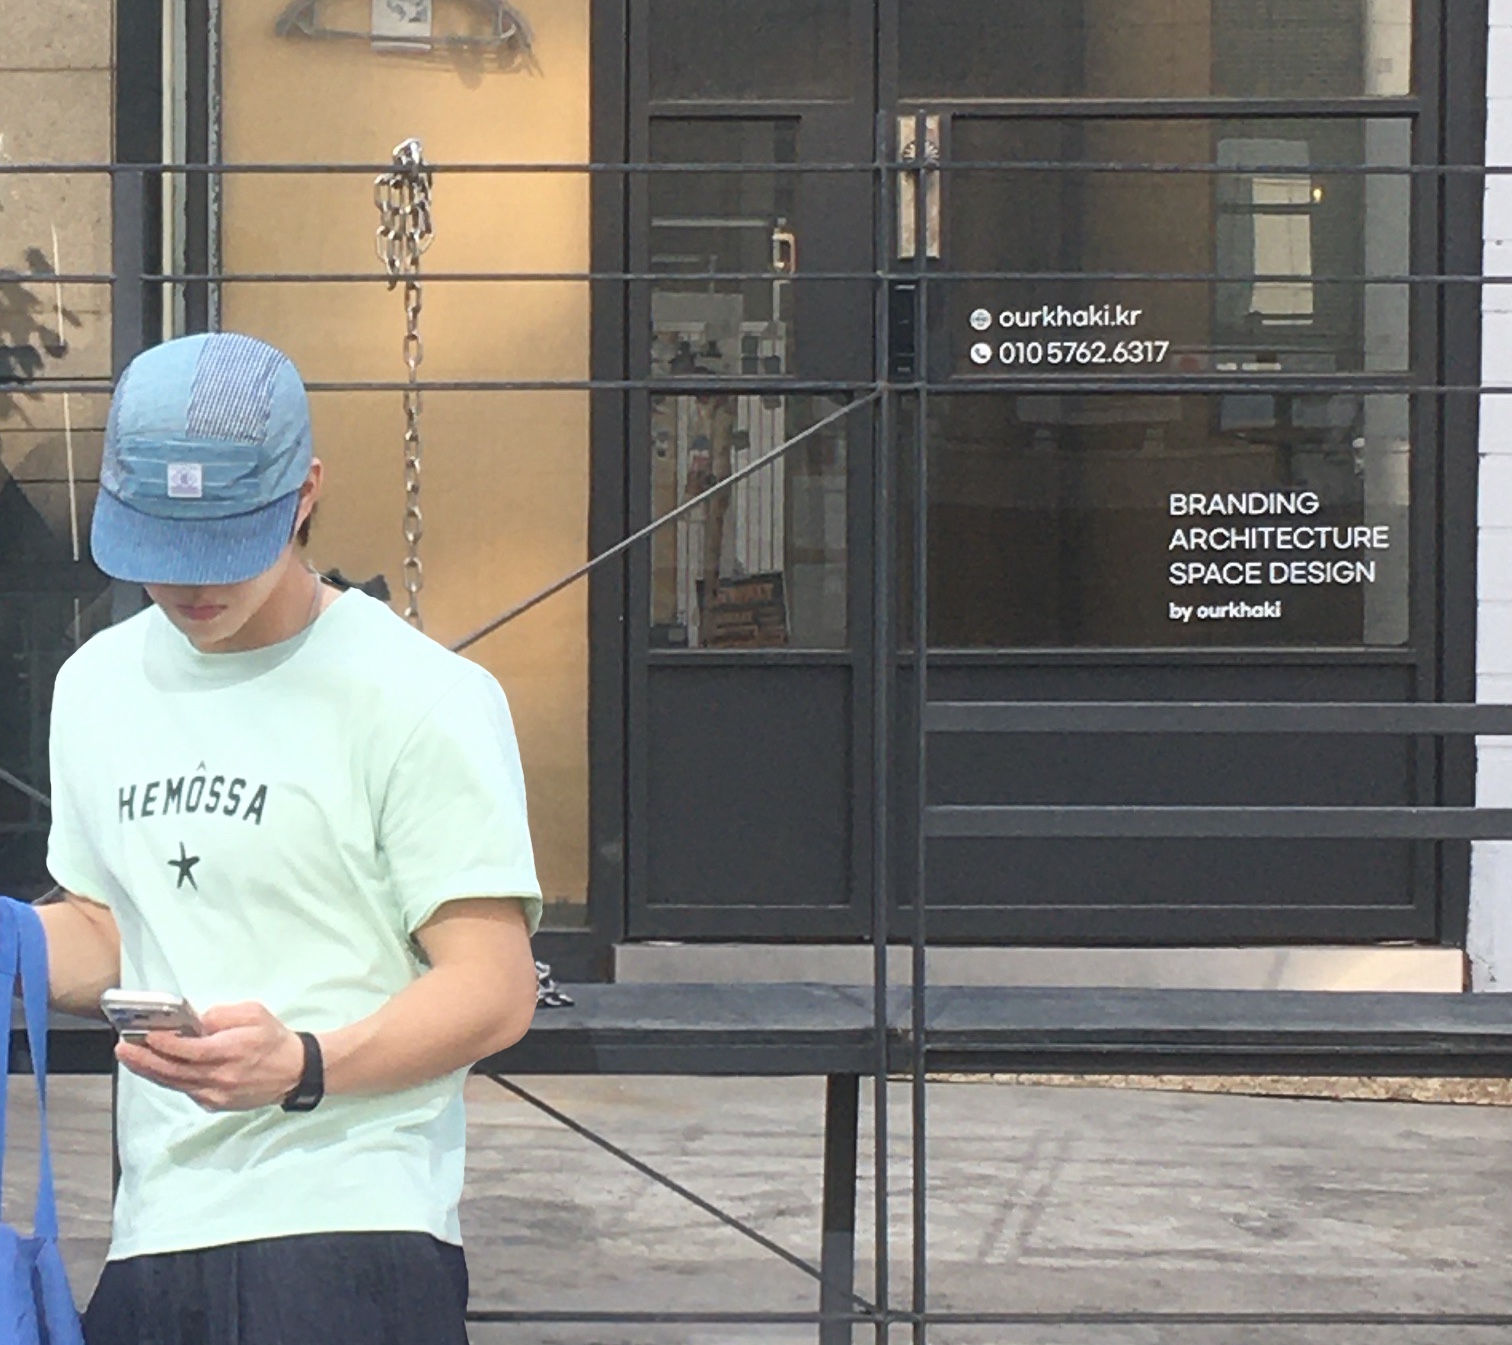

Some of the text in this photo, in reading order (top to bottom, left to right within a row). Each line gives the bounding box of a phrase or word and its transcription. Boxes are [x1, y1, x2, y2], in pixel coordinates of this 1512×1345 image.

[998, 304, 1143, 328] ourkhaki.kr
[1169, 491, 1320, 516] BRANDING
[1168, 525, 1390, 551] ARCHITECTURE
[1168, 560, 1376, 586] SPACE DESIGN
[1168, 600, 1282, 623] by ourkhaki
